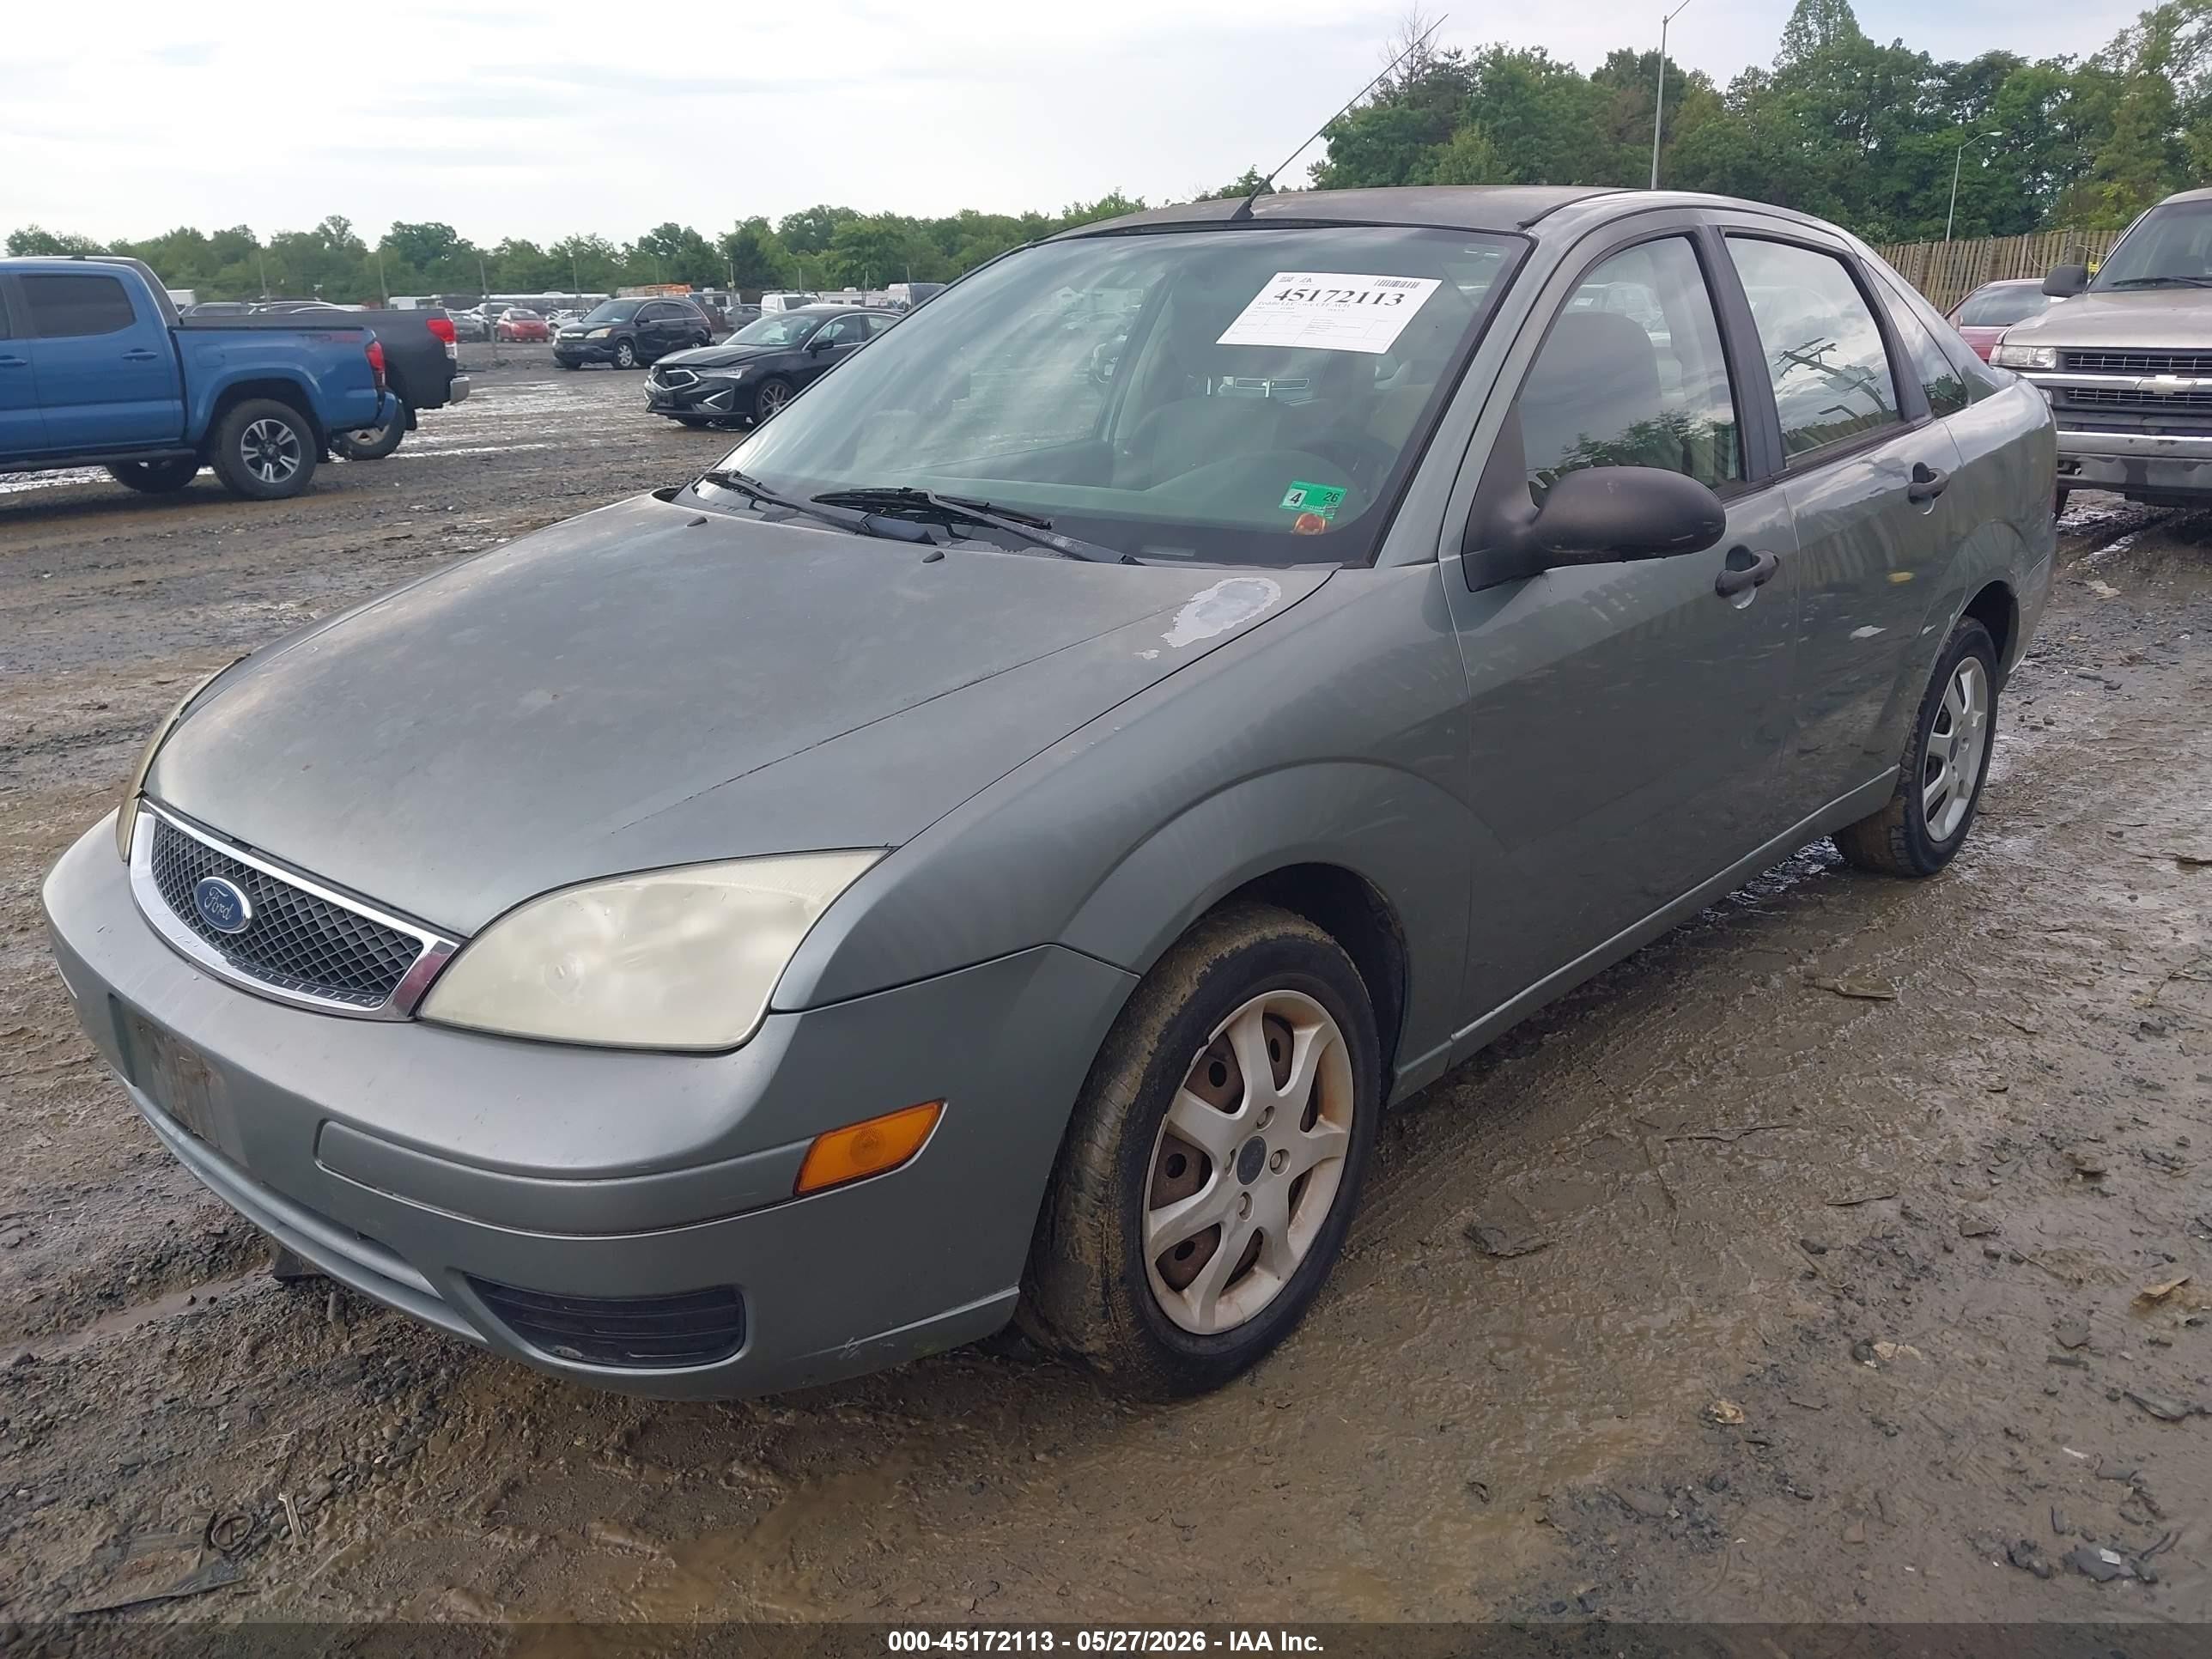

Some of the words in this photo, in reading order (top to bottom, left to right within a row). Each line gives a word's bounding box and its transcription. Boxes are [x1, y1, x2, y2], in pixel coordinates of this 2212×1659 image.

[1274, 288, 1405, 306] 45172113
[1291, 492, 1302, 503] 4
[1323, 492, 1340, 502] 26
[204, 886, 234, 921] Ford
